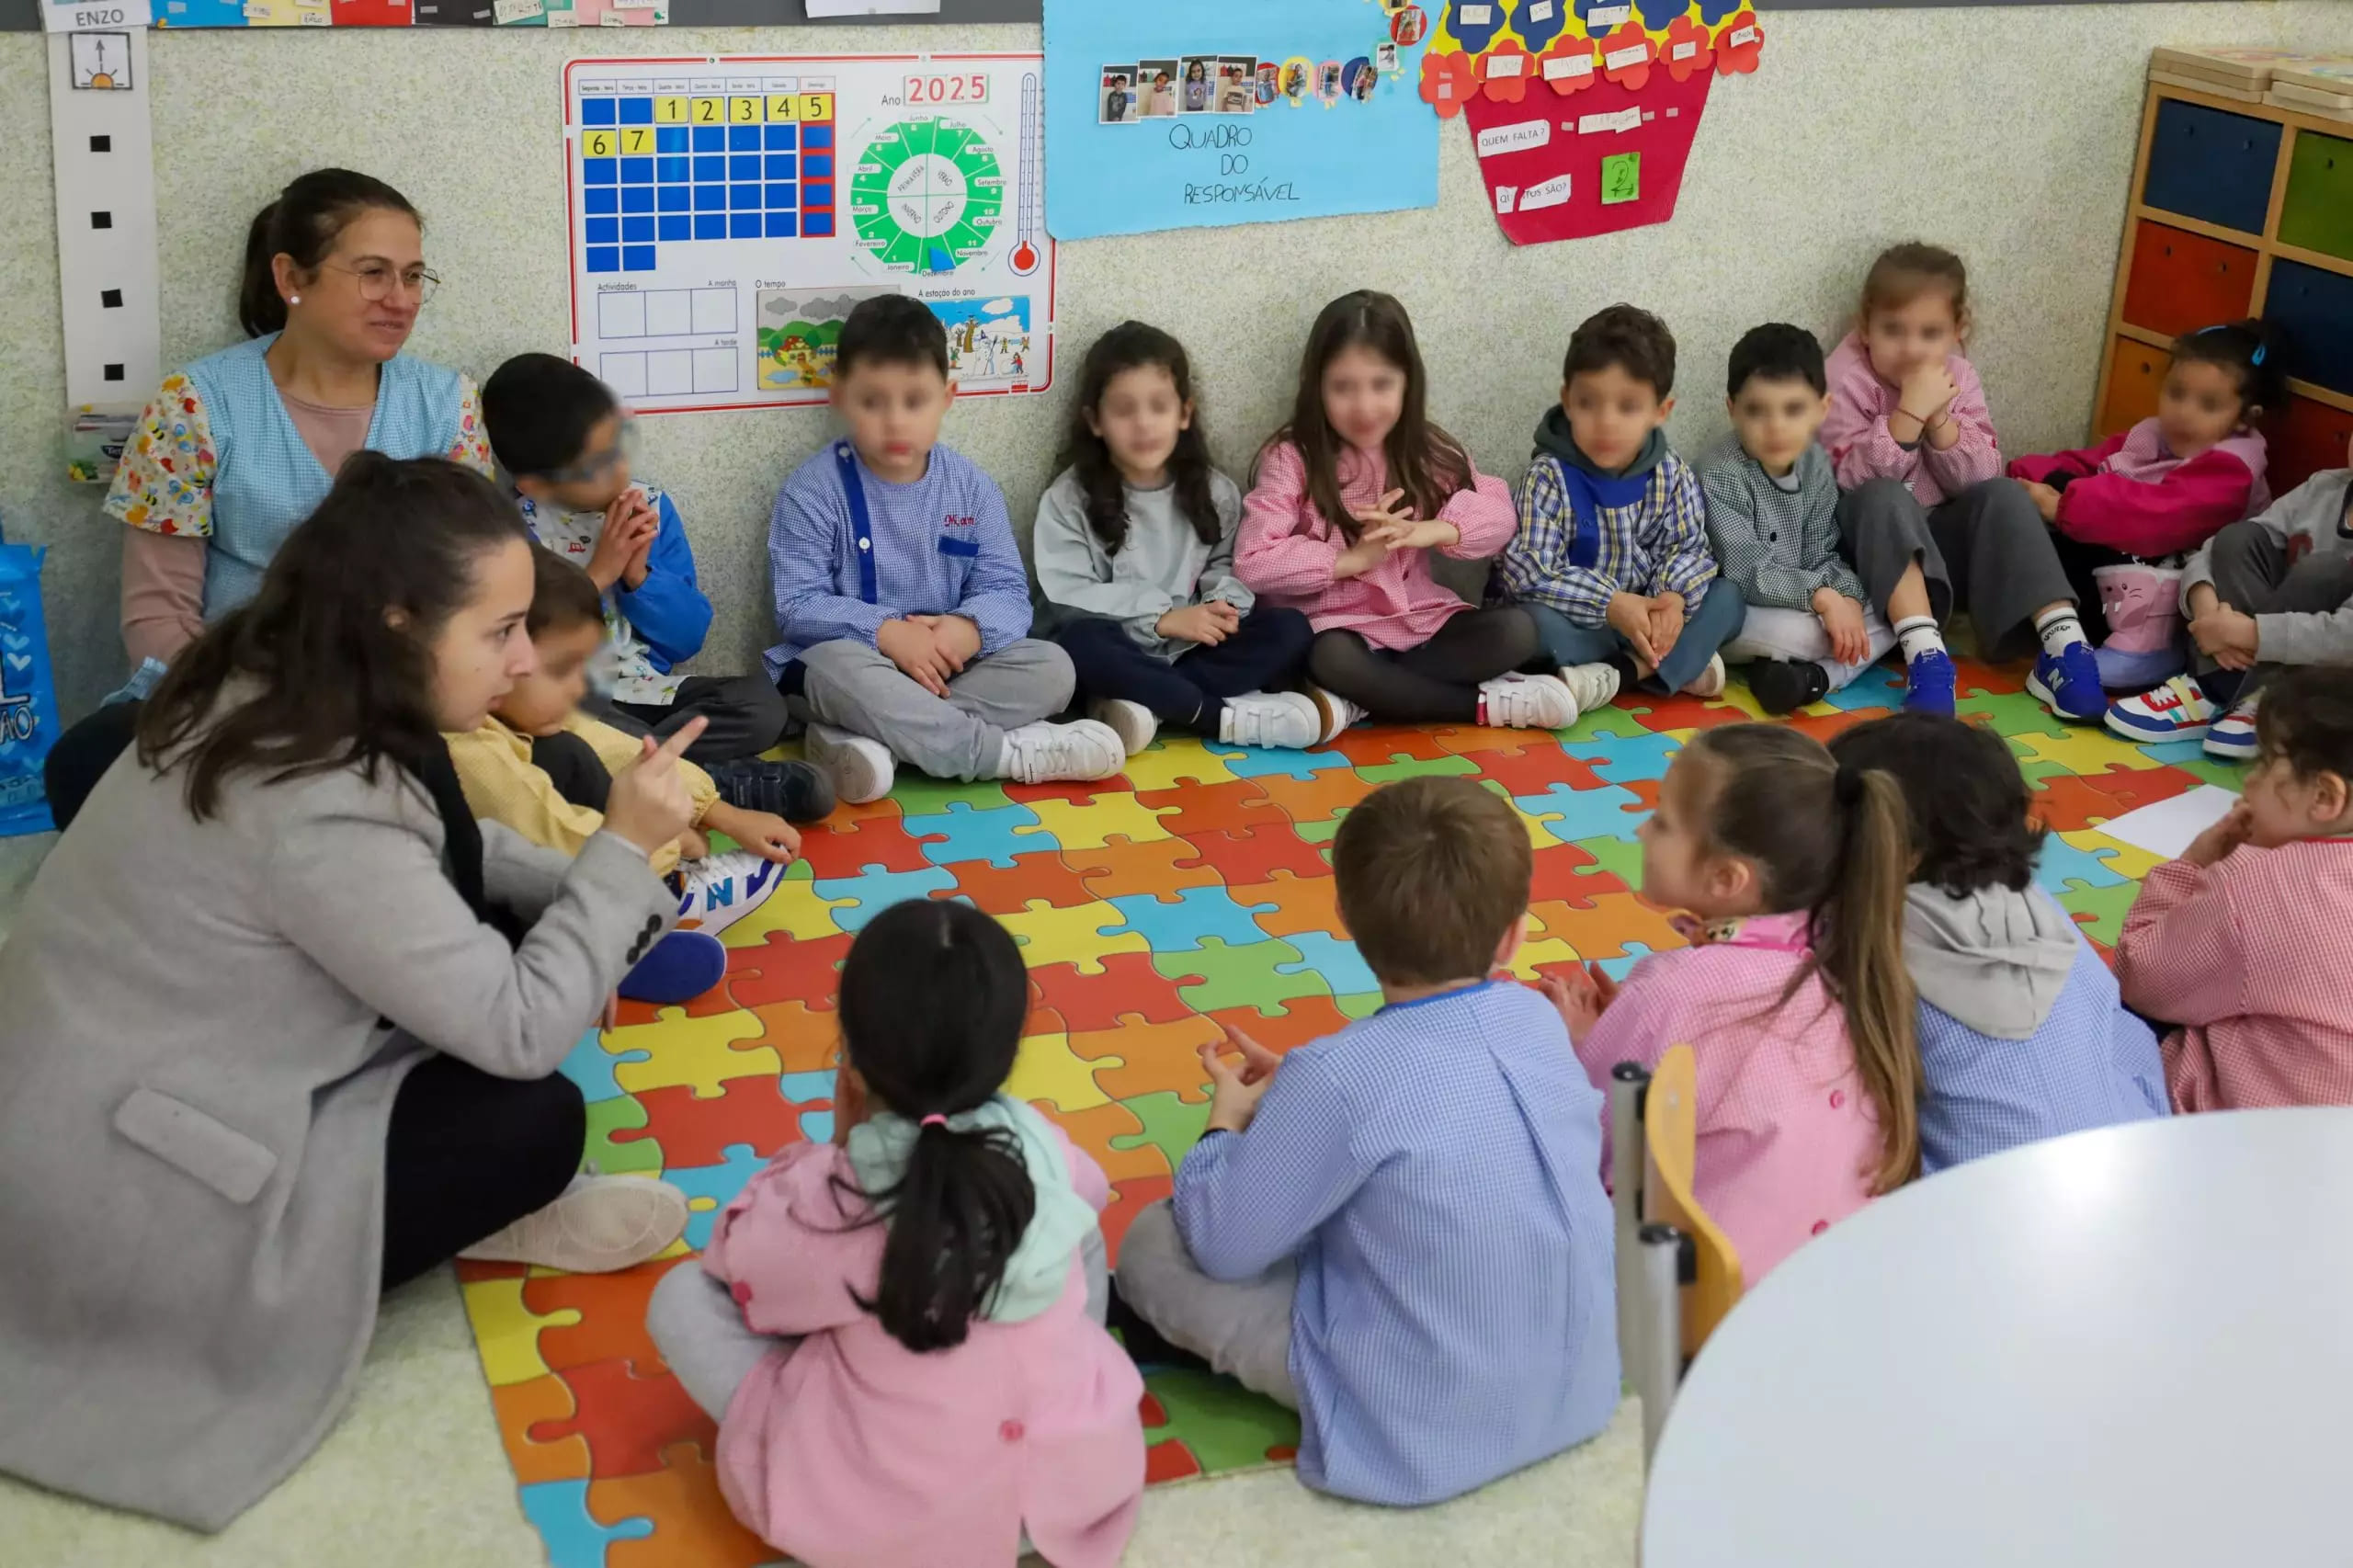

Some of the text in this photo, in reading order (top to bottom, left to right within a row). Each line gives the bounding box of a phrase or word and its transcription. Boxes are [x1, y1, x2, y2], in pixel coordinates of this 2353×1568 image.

[75, 9, 125, 27] ENZO
[881, 75, 985, 107] Ano 2025
[668, 97, 822, 120] 1 2 3 4 5
[593, 130, 643, 154] 6 7
[1169, 123, 1253, 150] QUADRO
[1481, 134, 1508, 147] QUEM
[1513, 131, 1539, 142] FALTA
[972, 145, 994, 154] Agosto
[1221, 153, 1248, 176] DO
[977, 177, 1007, 186] Setembro
[1610, 160, 1633, 195] 2
[1184, 176, 1301, 204] RESPONSÁVEL
[1545, 182, 1567, 195] SÃO?
[976, 218, 1003, 226] Outubro
[855, 239, 886, 247] Fevereiro
[956, 249, 988, 257] Novembro
[597, 281, 637, 291] Actividades
[755, 279, 786, 290] O tempo
[952, 288, 961, 296] do
[706, 875, 733, 912] N
